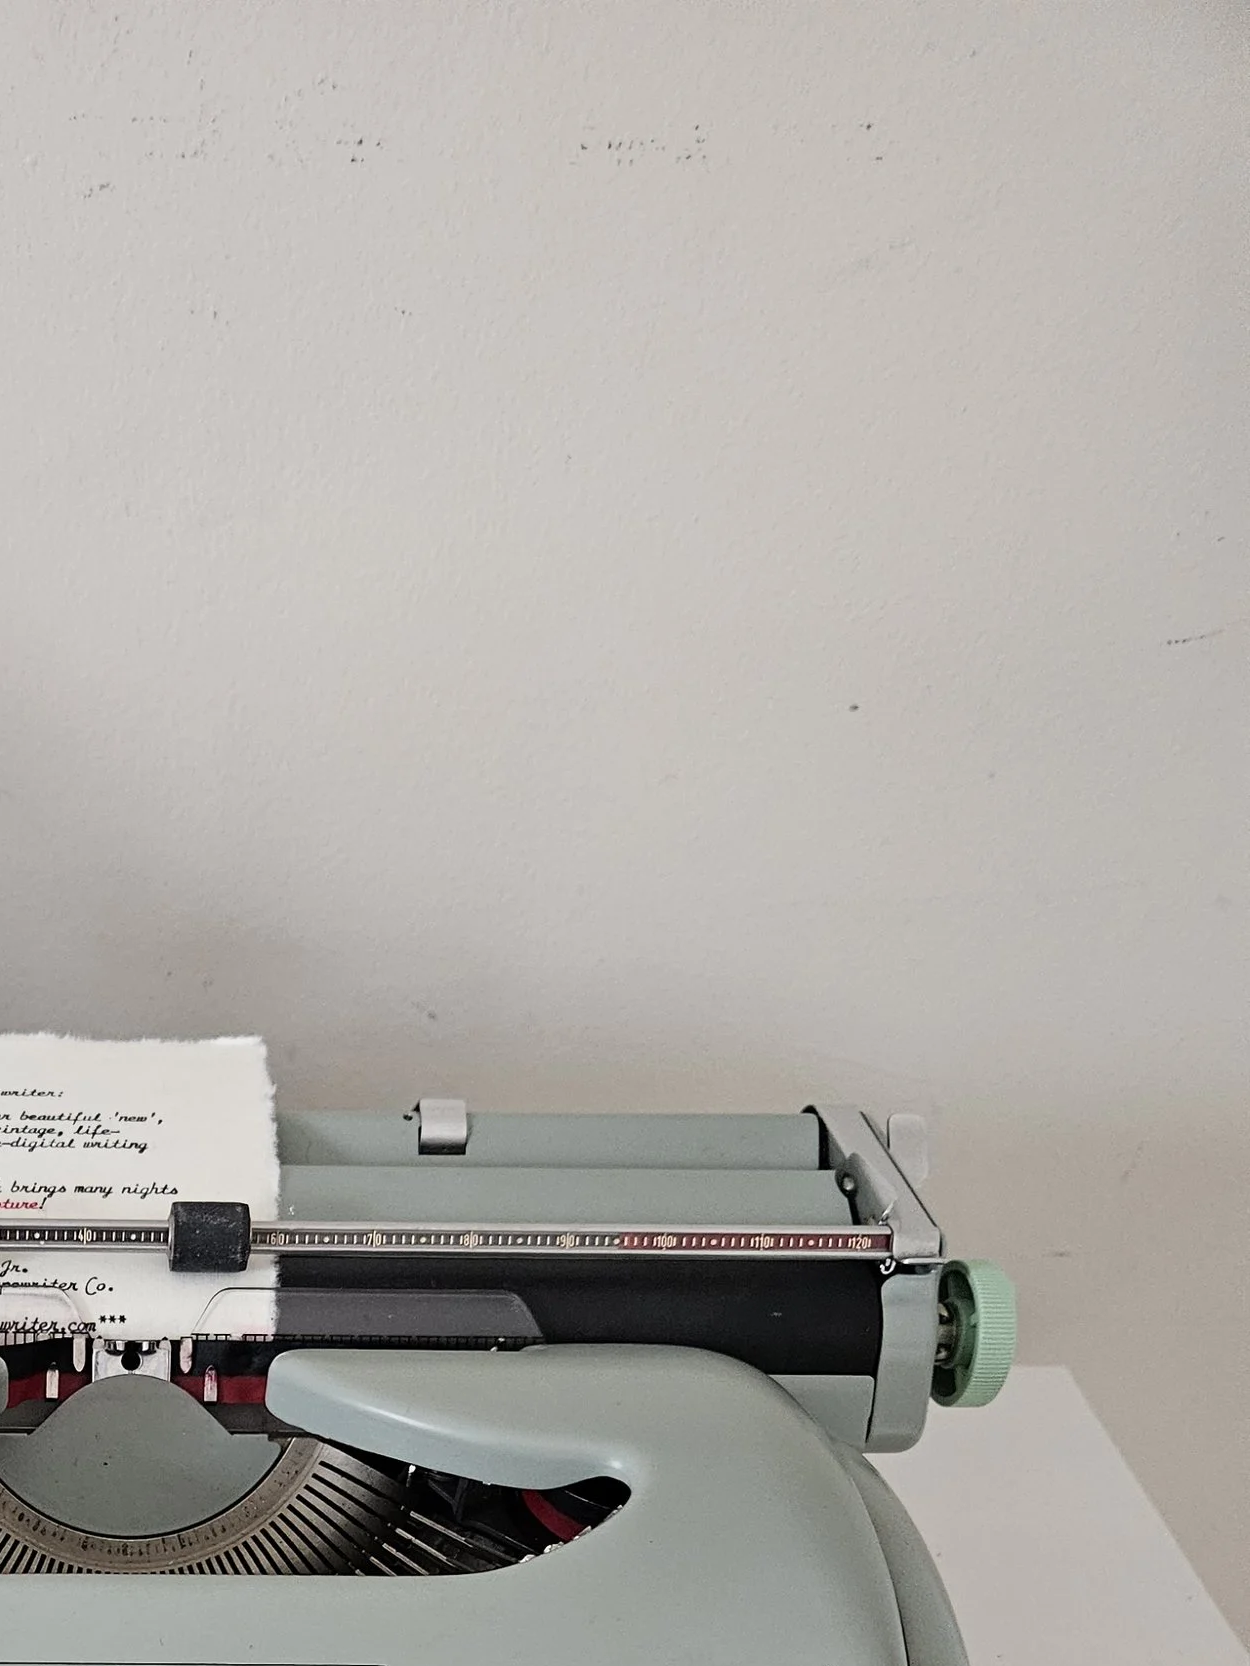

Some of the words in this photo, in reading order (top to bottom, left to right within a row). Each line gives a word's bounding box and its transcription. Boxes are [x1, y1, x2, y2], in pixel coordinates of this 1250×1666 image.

[0, 1088, 64, 1098] writer:
[19, 1110, 101, 1125] beautiful
[73, 1124, 121, 1139] life-
[82, 1139, 148, 1154] writing
[10, 1180, 67, 1198] brings
[73, 1185, 113, 1199] many
[121, 1182, 179, 1199] nights
[0, 1259, 29, 1278] Jr.
[85, 1276, 114, 1296] Co.
